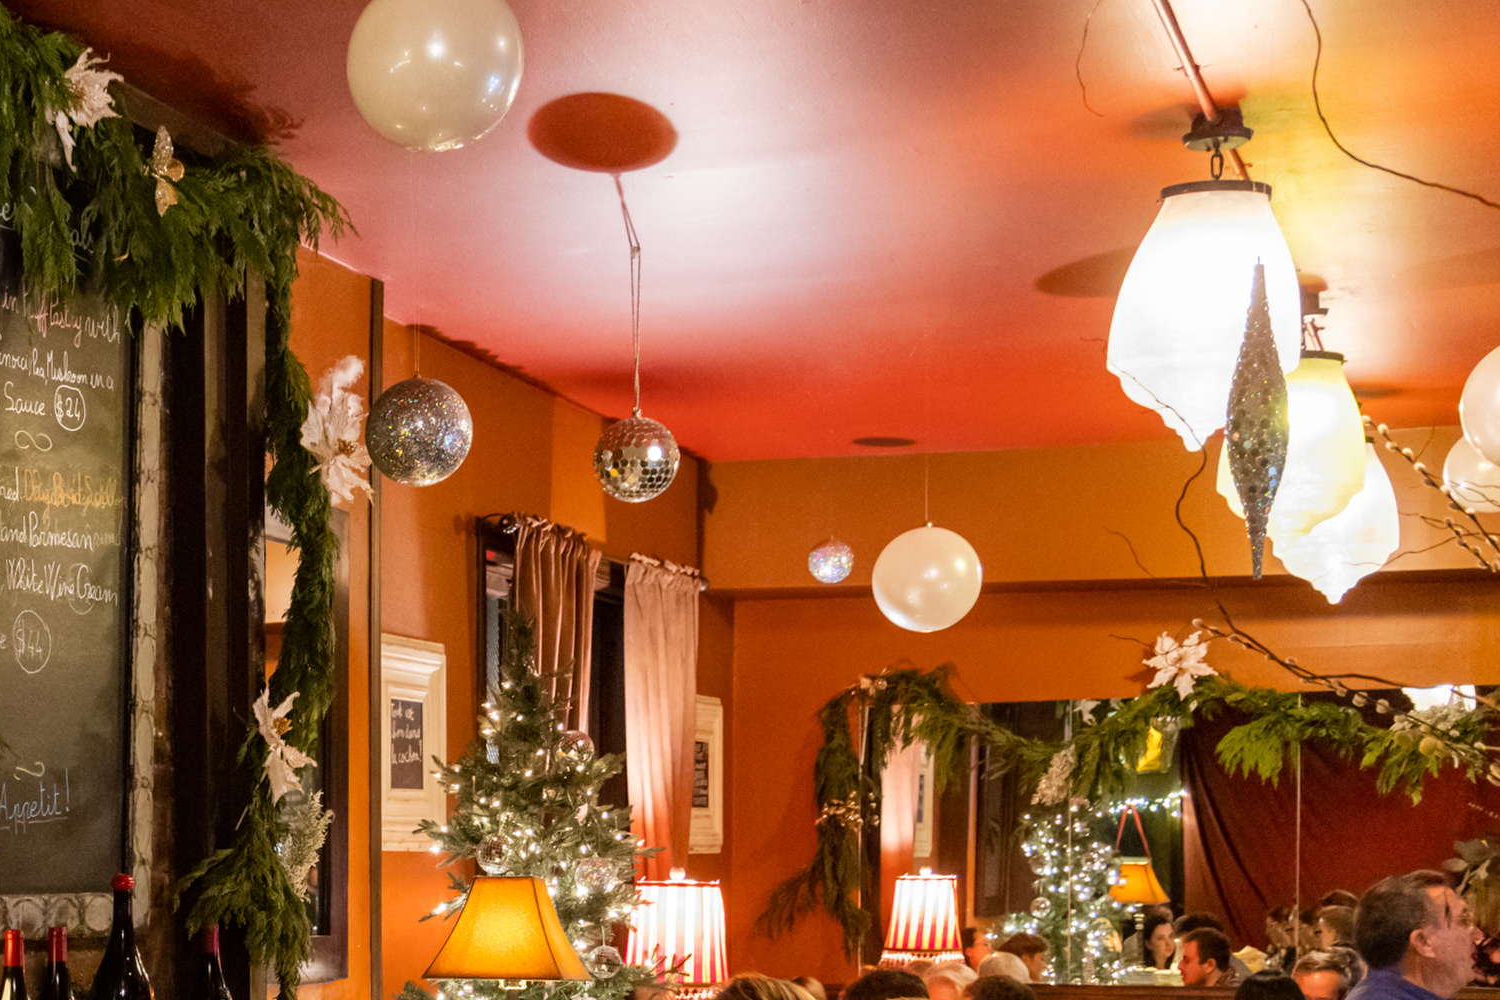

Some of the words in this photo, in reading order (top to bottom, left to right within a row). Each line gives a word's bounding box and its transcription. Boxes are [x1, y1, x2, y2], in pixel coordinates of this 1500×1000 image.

[107, 376, 114, 391] a
[56, 394, 81, 423] $24
[29, 511, 94, 552] Parmesan
[6, 557, 43, 594] White
[44, 560, 75, 601] Wine
[77, 564, 118, 606] Cream
